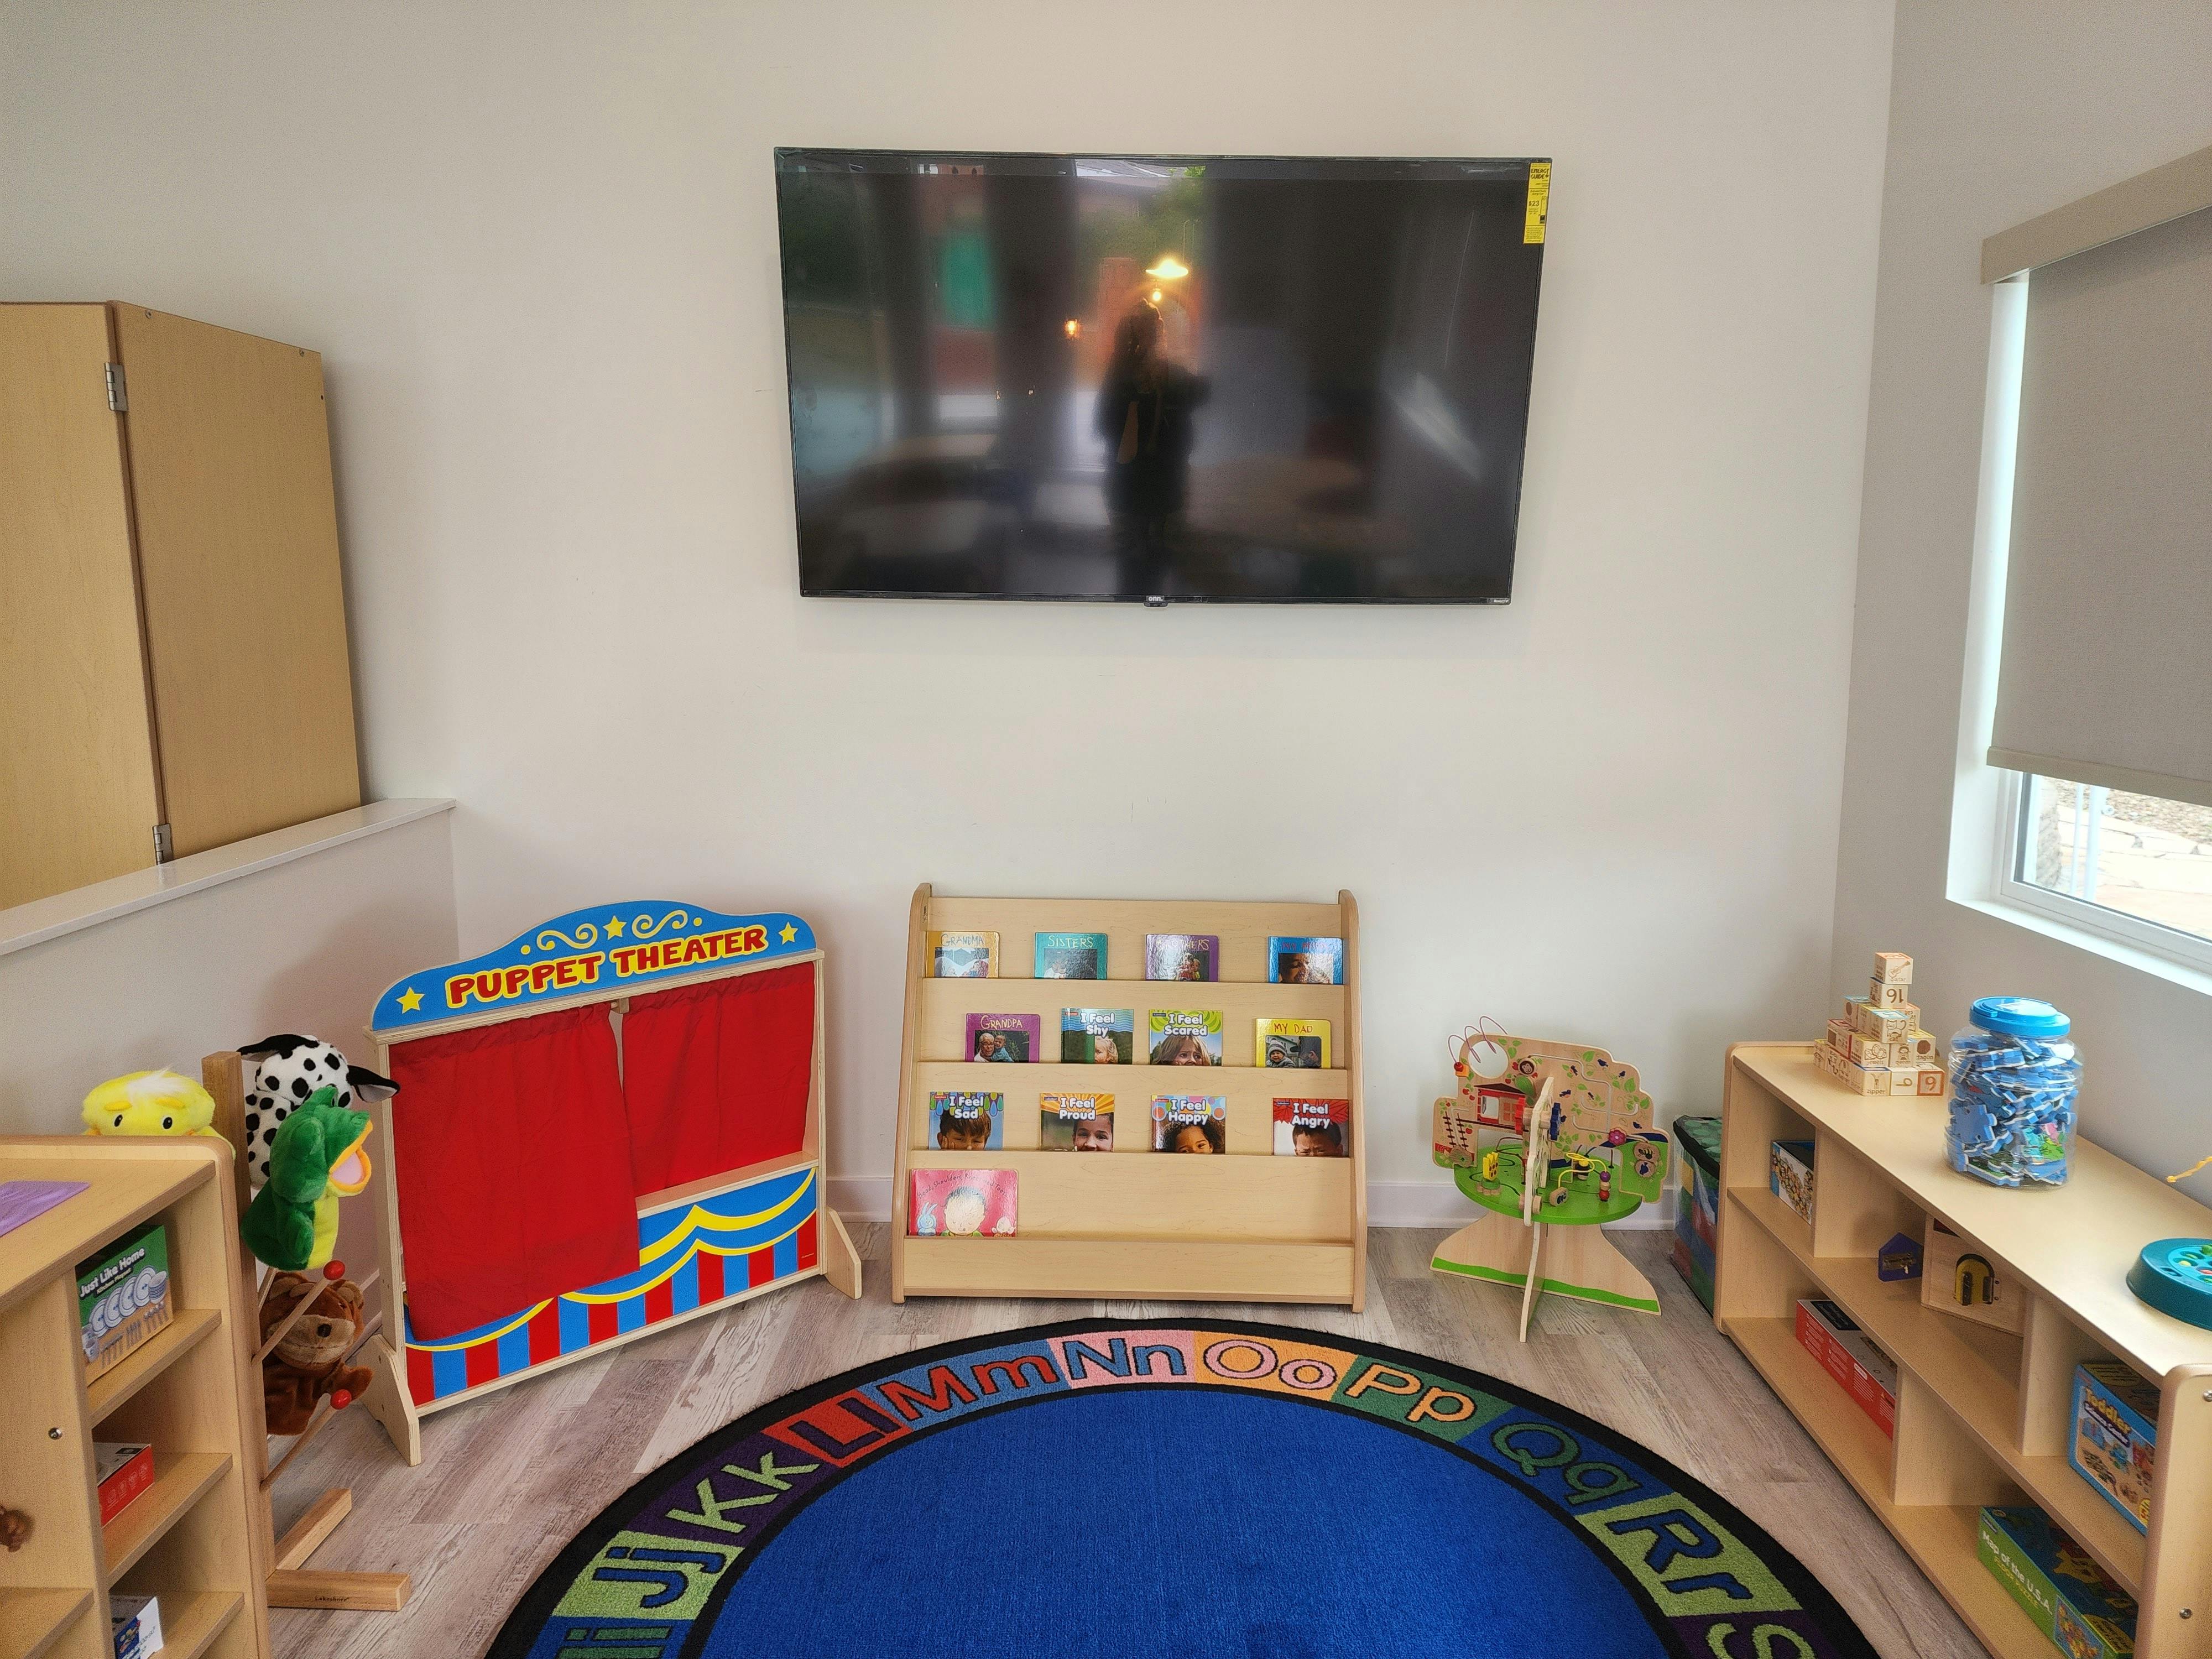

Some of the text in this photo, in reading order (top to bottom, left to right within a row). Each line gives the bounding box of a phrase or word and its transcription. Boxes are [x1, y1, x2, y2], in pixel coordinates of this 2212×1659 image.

[940, 933, 984, 947] GRANDMA
[1048, 935, 1093, 948] SISTERS
[447, 926, 768, 1006] PUPPET THEATER
[980, 1015, 1023, 1030] GRANDPA
[1080, 1013, 1114, 1024] I Feel
[1168, 1014, 1175, 1024] I
[1177, 1014, 1203, 1025] Feel
[1086, 1024, 1109, 1039] Shy
[1164, 1025, 1208, 1036] Scared
[1274, 1023, 1313, 1035] MY DAD
[949, 1095, 984, 1107] I Feel
[1060, 1097, 1095, 1108] I Feel
[1171, 1099, 1206, 1110] I Feel
[954, 1107, 978, 1119] Sad
[1060, 1109, 1095, 1120] Proud
[1293, 1103, 1328, 1114] I Feel
[1168, 1111, 1209, 1125] Happy
[1292, 1115, 1331, 1129] Angry
[80, 1248, 145, 1298] Just Like Home
[665, 1451, 821, 1534] Kk
[880, 1353, 1061, 1420] Mm
[1062, 1339, 1186, 1381] Nn
[1202, 1338, 1338, 1390] Oo
[1342, 1363, 1477, 1424] Pp
[1490, 1421, 1642, 1505] Qq
[1606, 1509, 1754, 1600] Rr
[1982, 1530, 2000, 1555] Map
[2001, 1553, 2010, 1567] of
[2011, 1562, 2025, 1583] the
[2027, 1579, 2053, 1616] U.S.A.
